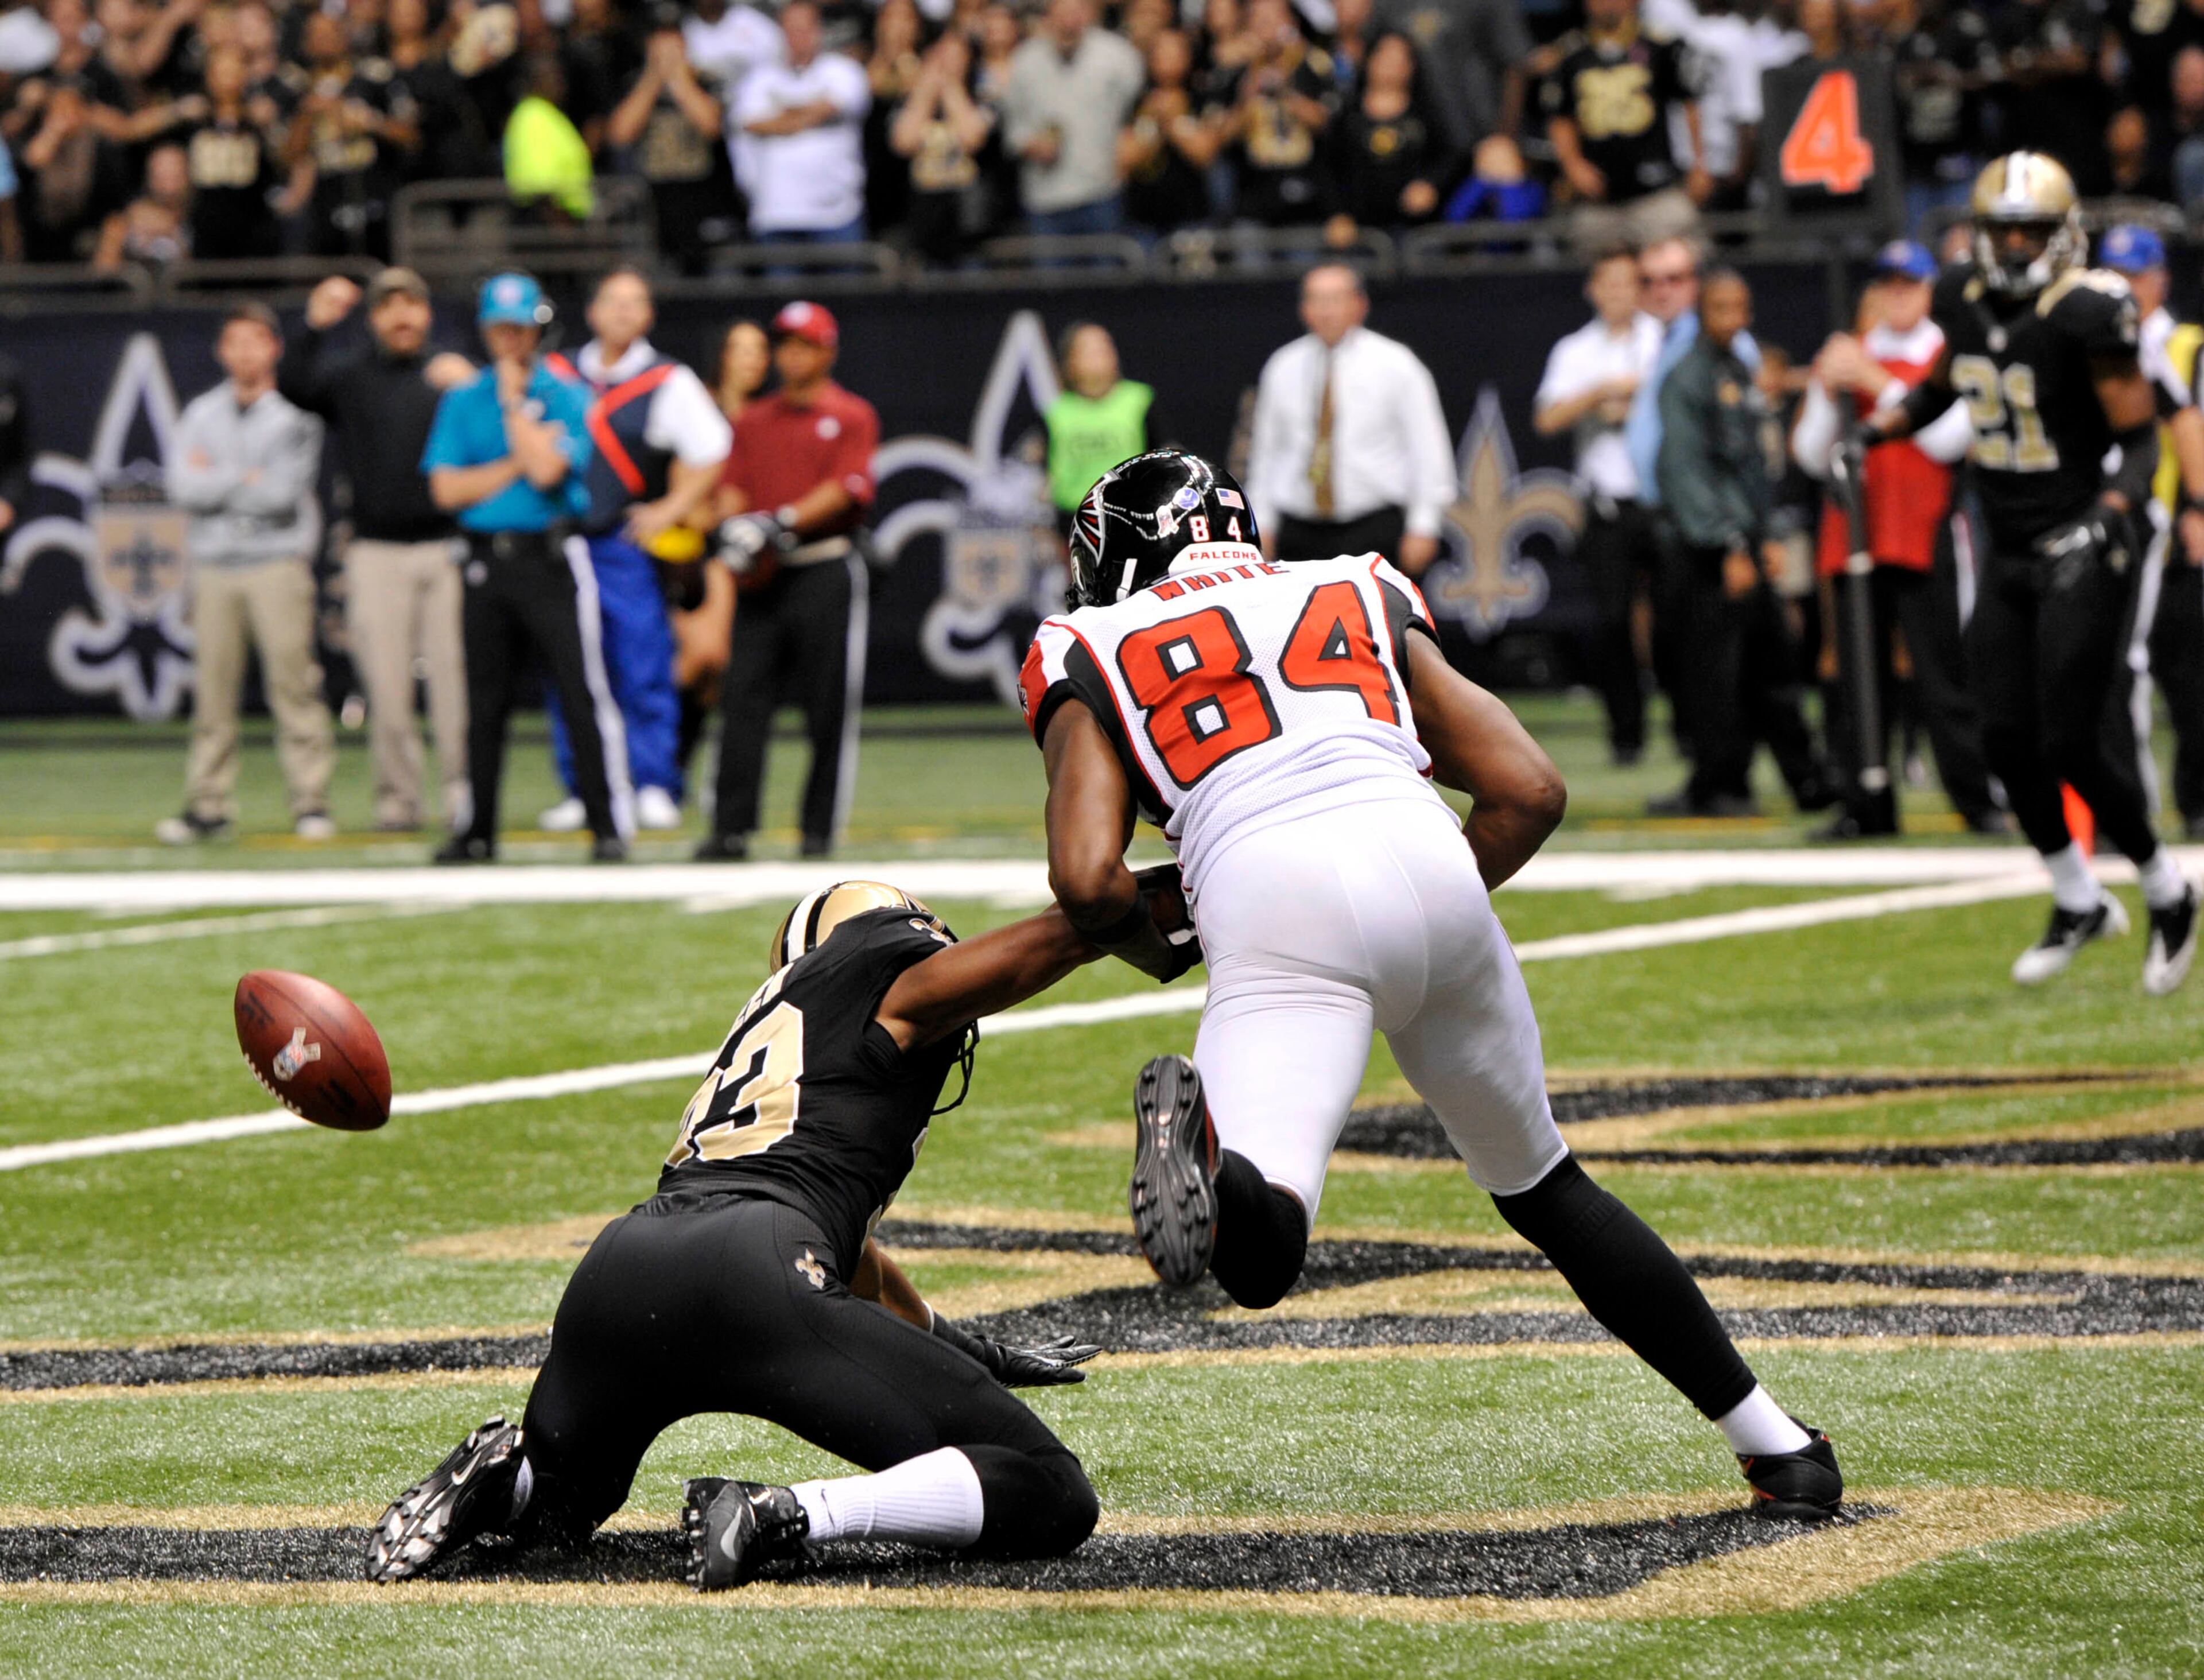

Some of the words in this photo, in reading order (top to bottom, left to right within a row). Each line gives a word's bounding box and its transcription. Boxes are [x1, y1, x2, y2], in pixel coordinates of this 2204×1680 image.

[1780, 70, 1873, 193] 4
[1951, 354, 2059, 473] 21
[1148, 562, 1291, 602] WHITE
[1189, 550, 1257, 561] FALCONS
[1116, 580, 1401, 790] 84
